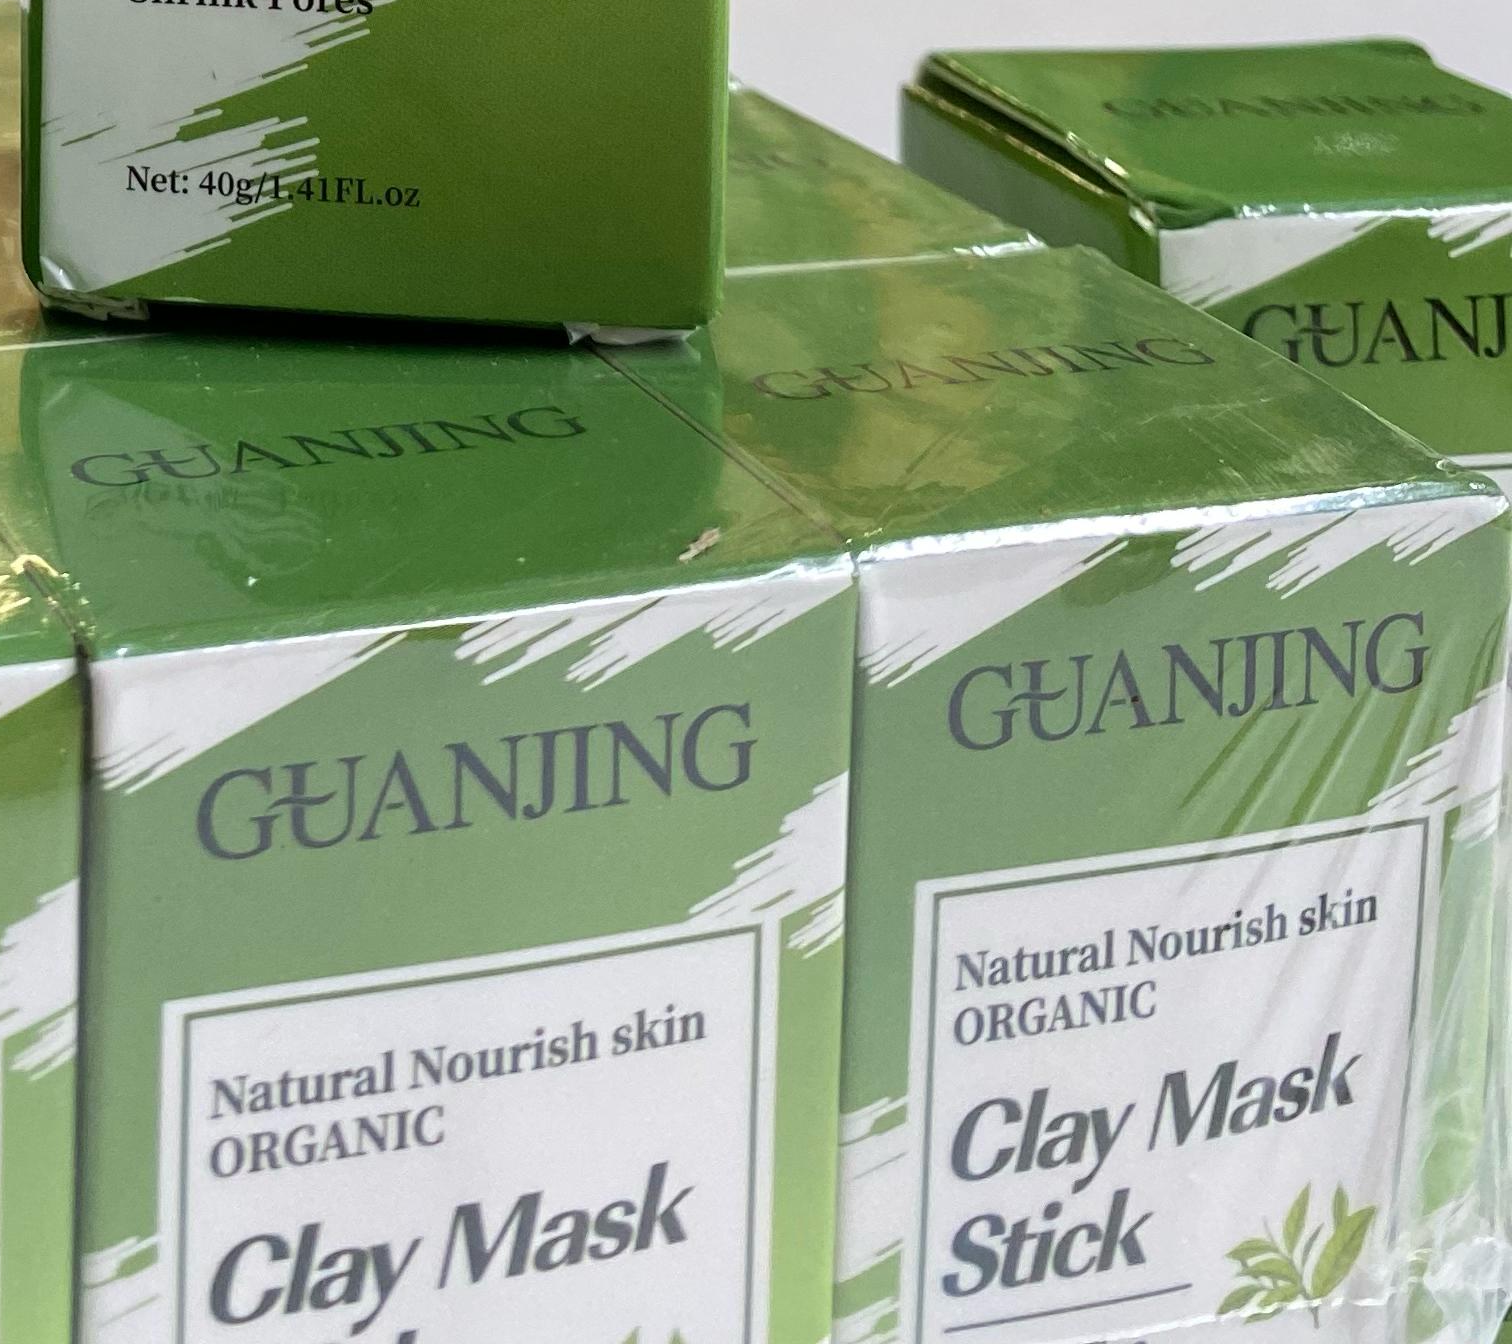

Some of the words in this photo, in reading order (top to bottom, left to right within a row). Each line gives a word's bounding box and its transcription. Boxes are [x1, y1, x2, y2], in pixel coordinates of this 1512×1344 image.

[125, 167, 189, 194] Net:
[198, 172, 420, 210] 40g/1.41FL.oz
[753, 337, 1216, 400] GUANJING
[70, 405, 588, 487] GUANJING
[948, 611, 1430, 752] GUANJING
[196, 703, 758, 861] GUANJING
[954, 930, 1115, 992] Natural
[1127, 903, 1288, 967] Nourish
[1299, 889, 1379, 935] skin
[208, 1051, 395, 1121] Natural
[408, 1021, 600, 1091] Nourish
[611, 1002, 706, 1057] skin
[954, 981, 1157, 1045] ORGANIC
[209, 1105, 445, 1179] ORGANIC
[951, 1088, 1135, 1194] Clay
[1148, 1031, 1364, 1153] Mask
[208, 1222, 424, 1336] Clay
[438, 1160, 696, 1288] Mask
[941, 1187, 1154, 1298] Stick
